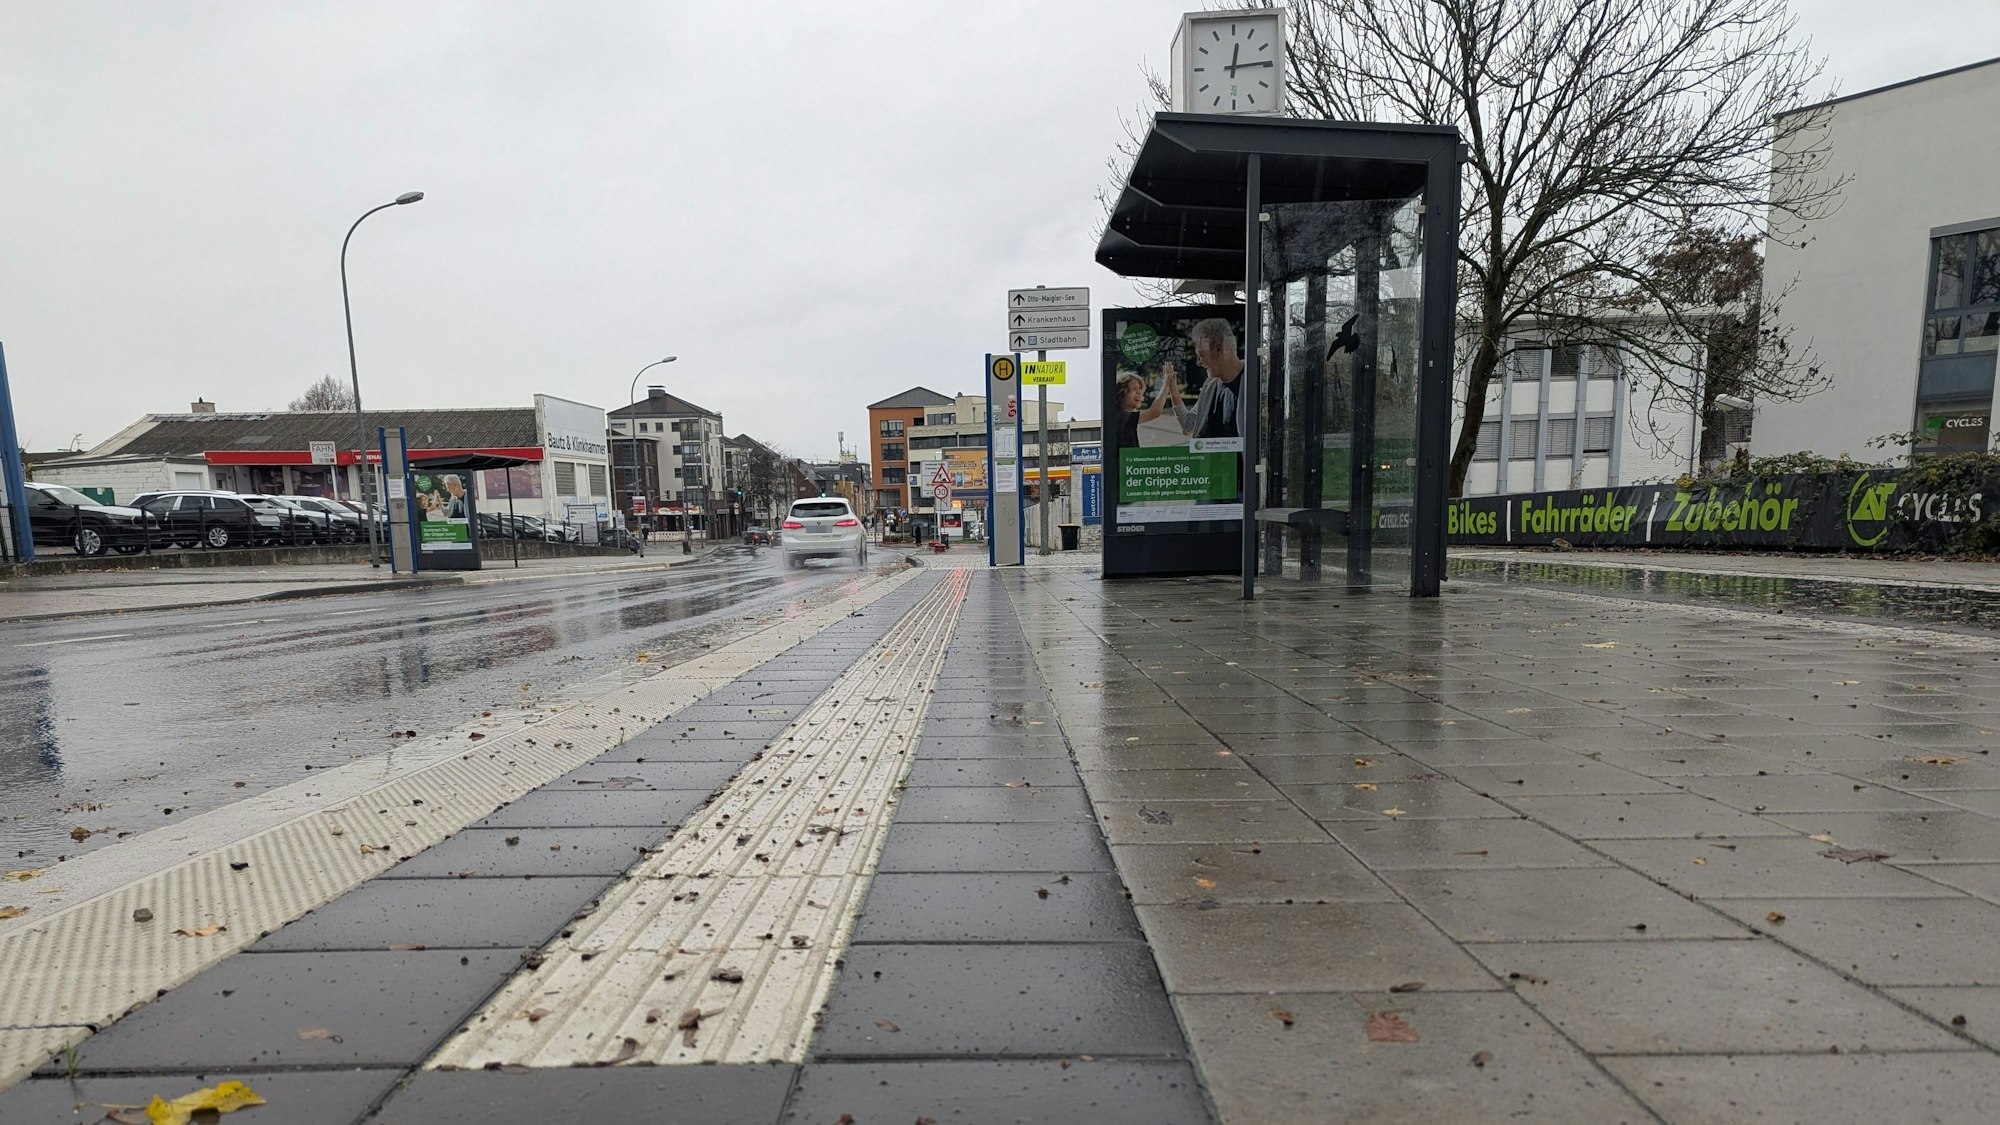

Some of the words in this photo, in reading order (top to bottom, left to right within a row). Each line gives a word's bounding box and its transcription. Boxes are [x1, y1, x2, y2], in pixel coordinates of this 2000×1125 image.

[1027, 293, 1075, 303] Otto-Maigler-See
[1027, 315, 1076, 324] Krankenhaus
[1040, 336, 1077, 344] Stadtbahn
[998, 362, 1008, 376] H
[1025, 364, 1063, 374] INNATURA
[1946, 417, 1984, 428] CYCLES
[547, 432, 566, 450] Bautz
[566, 435, 572, 451] &
[571, 436, 606, 455] Klinkhammer
[1126, 465, 1171, 476] Kommen
[1173, 464, 1190, 474] Sie
[1126, 477, 1142, 487] der
[1145, 476, 1179, 488] Grippe
[1181, 476, 1211, 485] zuvor.
[937, 488, 946, 496] 30
[1665, 481, 1800, 532] Zubehör
[1521, 492, 1638, 533] Fahrräder
[1447, 504, 1497, 535] Bikes
[1116, 525, 1145, 533] STRÖER
